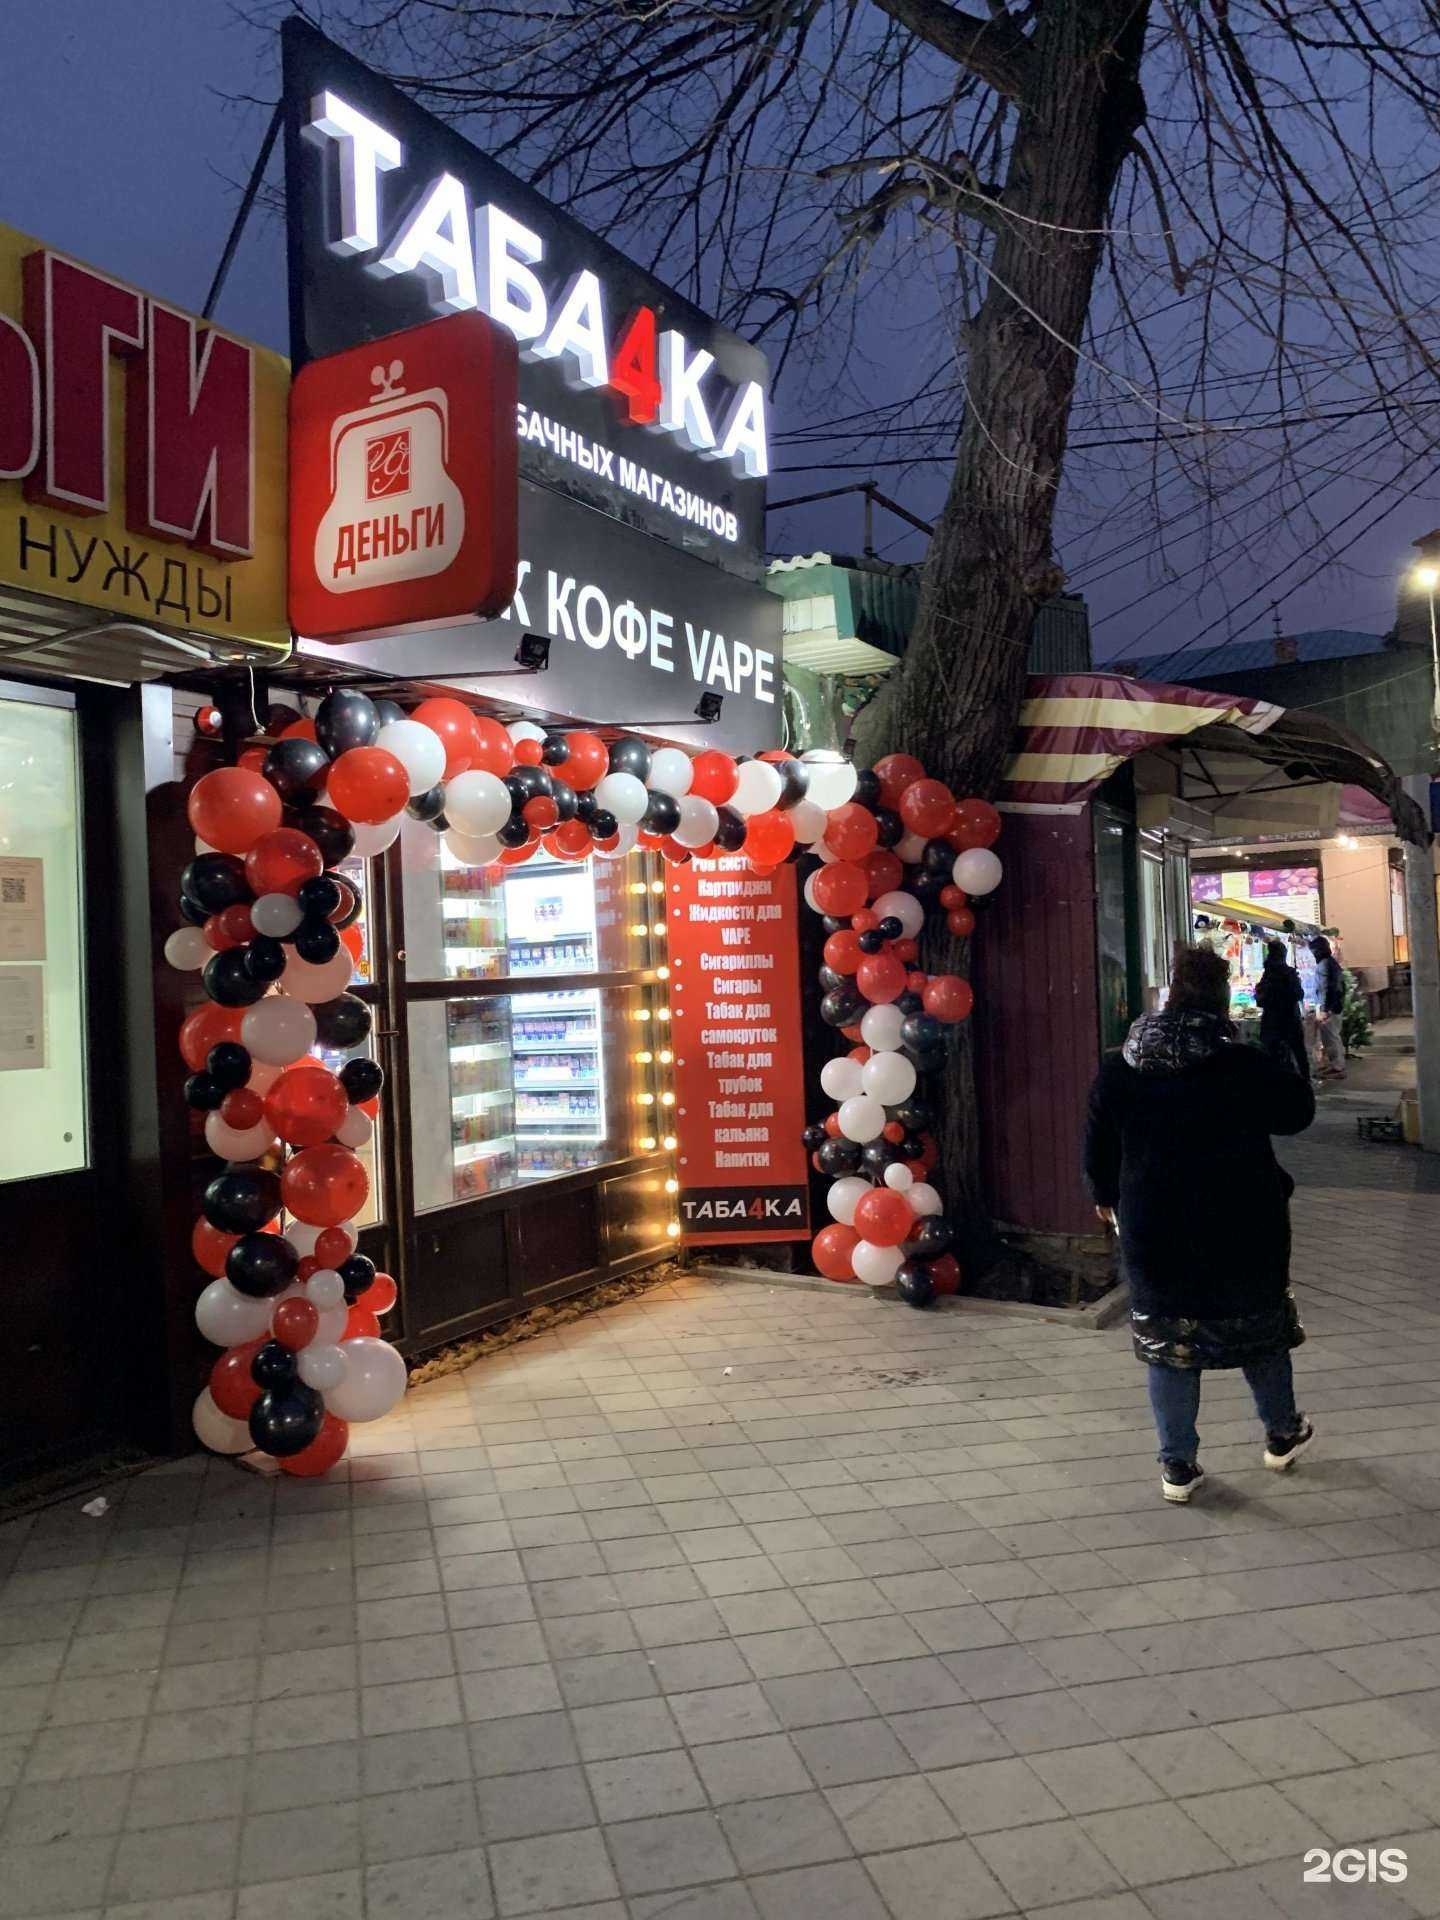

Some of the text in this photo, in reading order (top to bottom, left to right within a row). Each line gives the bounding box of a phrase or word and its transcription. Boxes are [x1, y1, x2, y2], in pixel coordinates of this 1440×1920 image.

[311, 89, 769, 477] ТАБА4КА
[619, 456, 738, 542] МАГАЗИНОВ
[333, 503, 445, 578] ДЕНЬГИ
[19, 516, 232, 622] НУЖДЫ
[548, 570, 674, 673] КОФЕ
[685, 622, 774, 703] VAPE
[697, 879, 772, 897] Картриджи
[688, 903, 782, 923] Жидкости для
[721, 927, 751, 945] VAPE
[700, 953, 774, 971] Сигариллы
[713, 977, 762, 995] Сигары
[705, 1002, 771, 1021] Табак для
[701, 1028, 777, 1045] самокруток
[707, 1051, 772, 1070] Табак для
[718, 1075, 763, 1094] трубок
[708, 1100, 774, 1120] Табак для
[714, 1127, 769, 1144] кальяна
[715, 1150, 770, 1168] Напитки
[682, 1198, 802, 1219] ТАБА4КА
